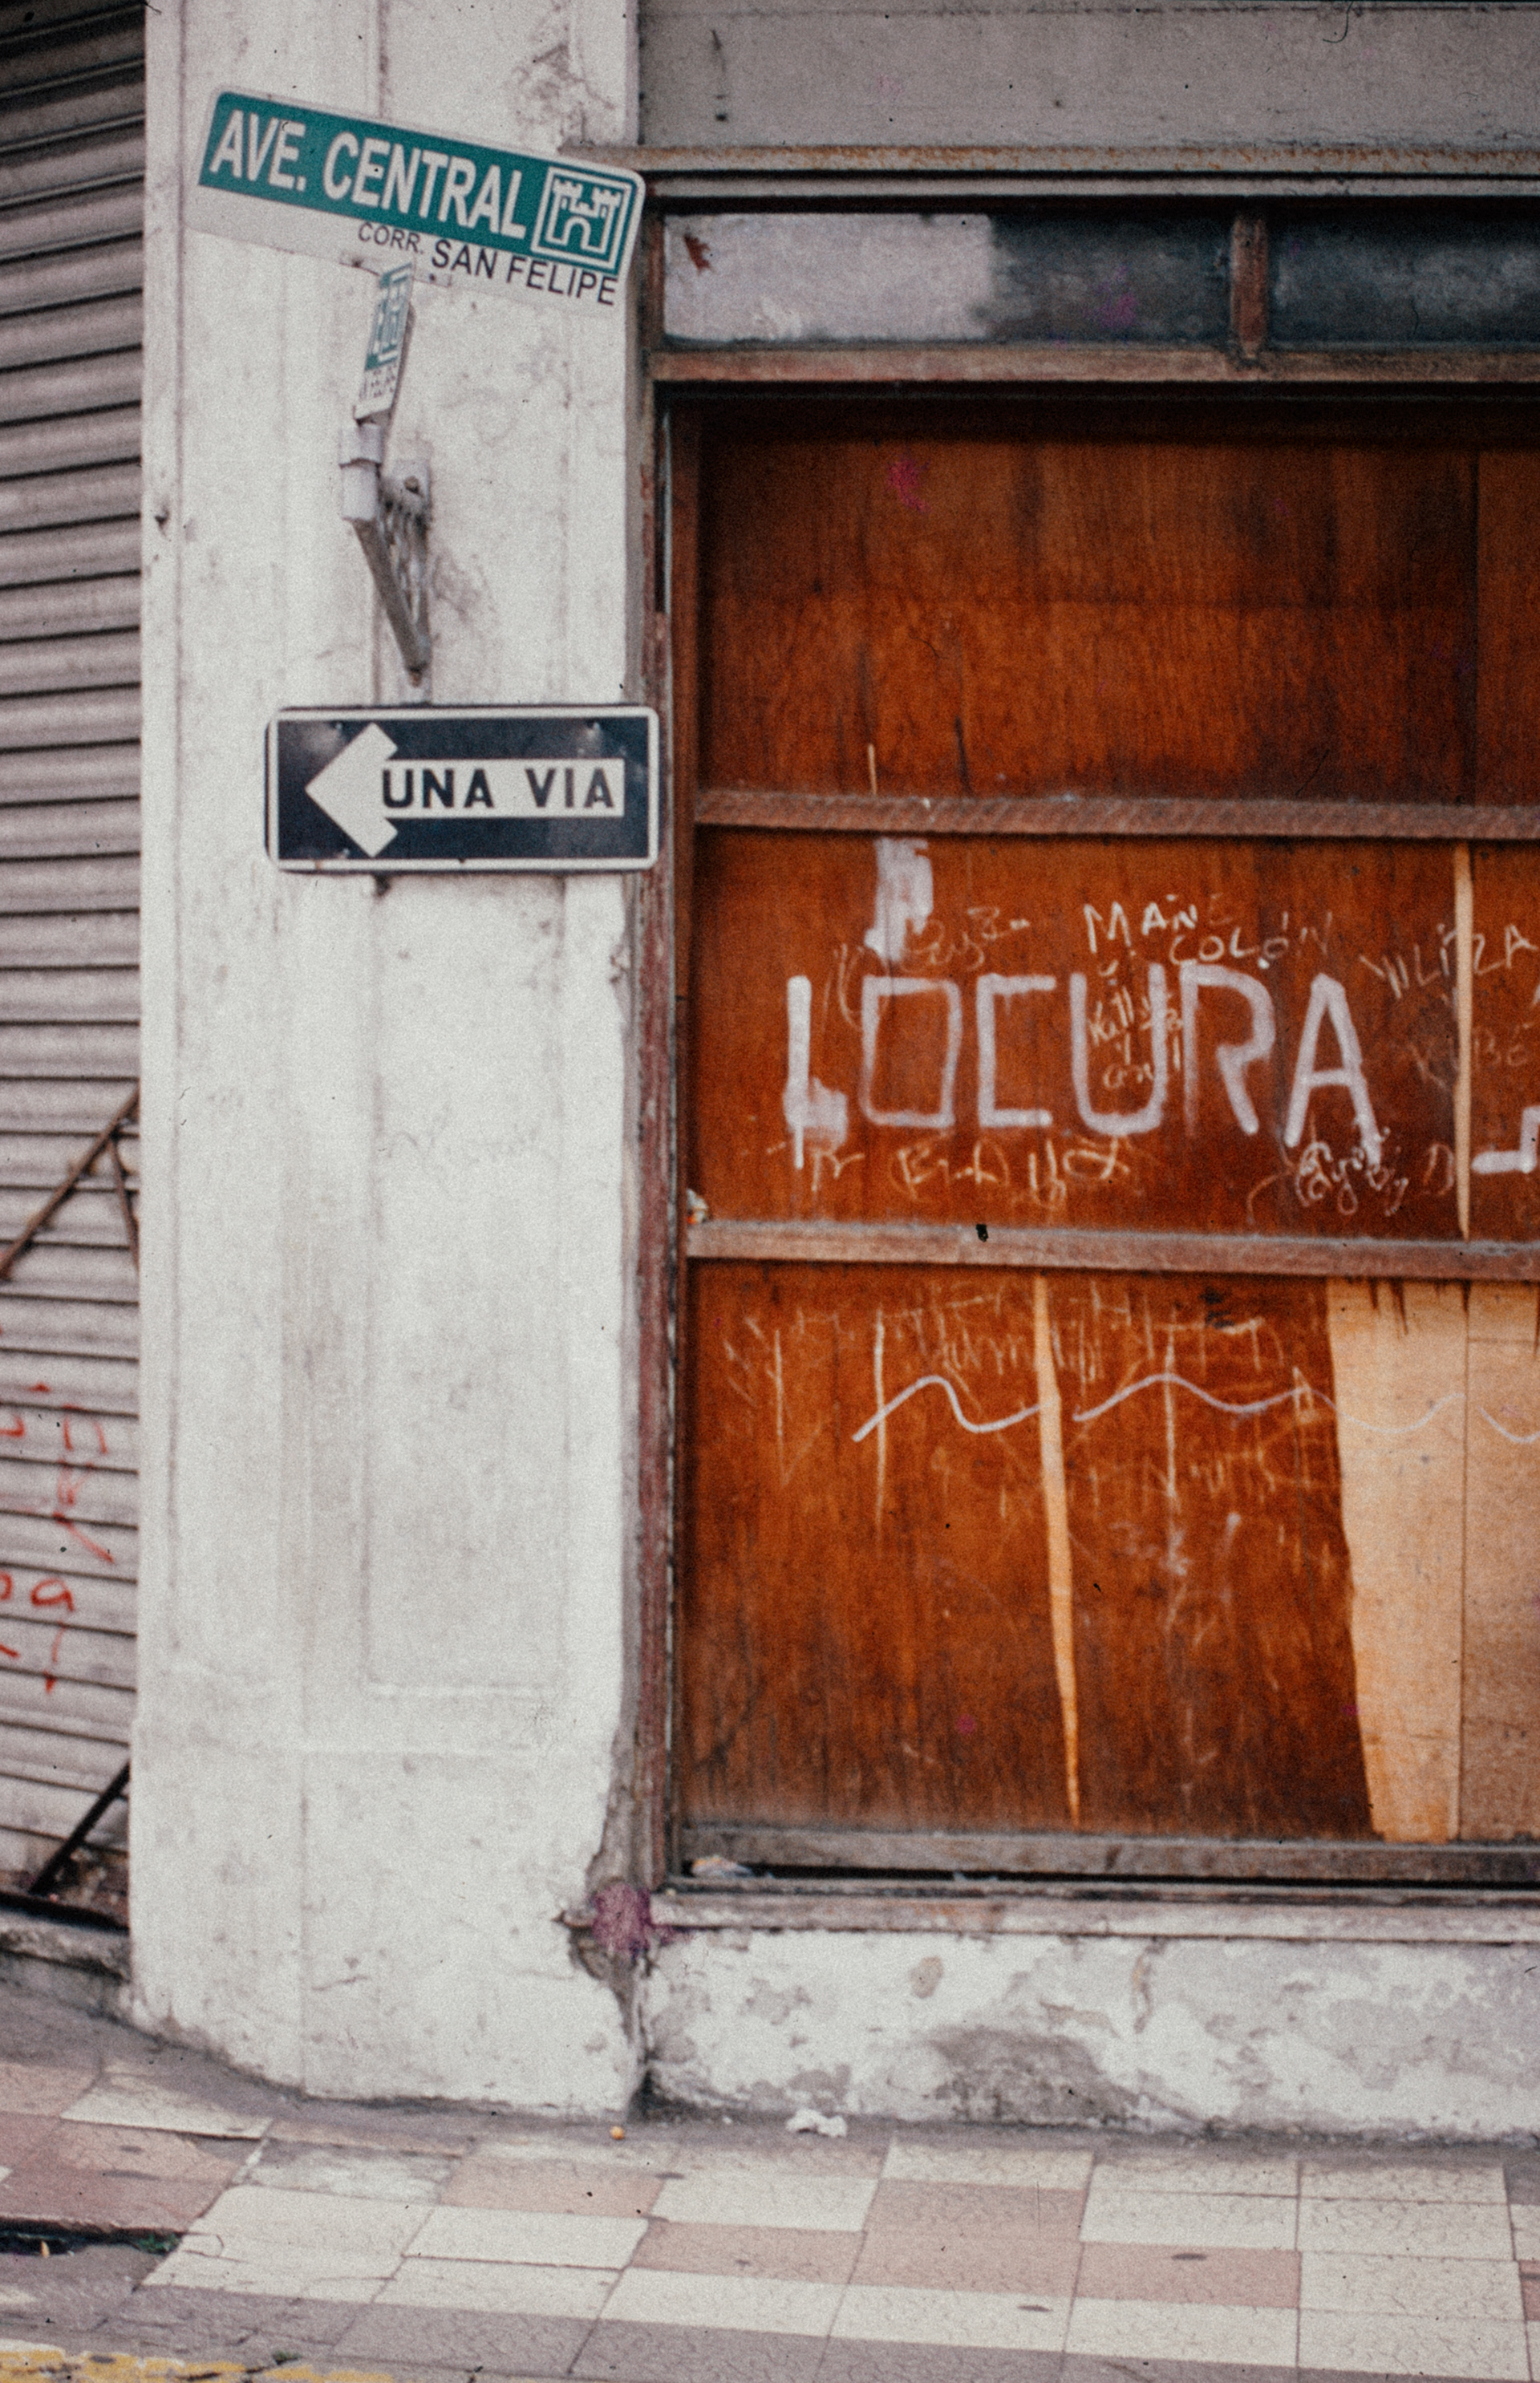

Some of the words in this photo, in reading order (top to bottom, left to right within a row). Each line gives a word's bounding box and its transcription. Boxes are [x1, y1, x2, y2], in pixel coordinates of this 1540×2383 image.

[209, 109, 307, 193] AVE.
[322, 132, 527, 240] CENTRAL
[358, 221, 424, 255] CORR.
[431, 239, 497, 279] SAN
[505, 255, 619, 306] FELIPE
[382, 768, 495, 809] UNA
[525, 768, 615, 809] VIA
[781, 961, 1383, 1169] LOCURA
